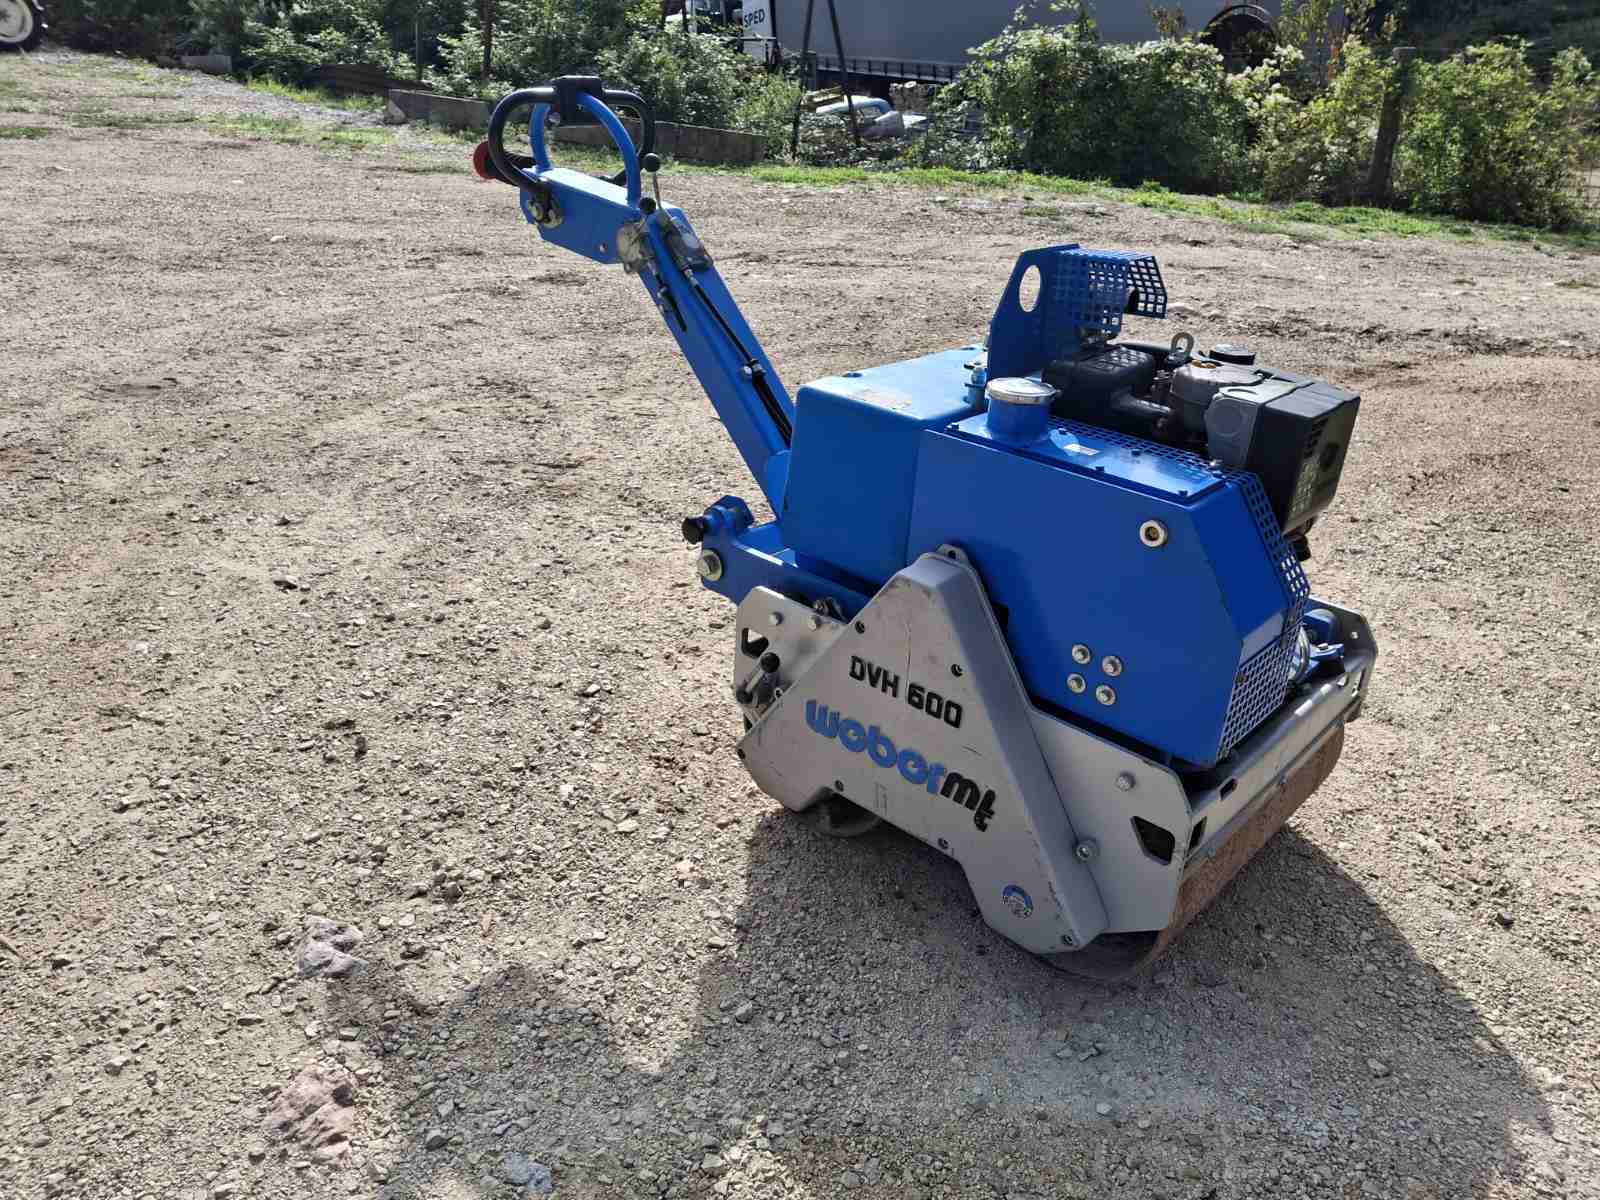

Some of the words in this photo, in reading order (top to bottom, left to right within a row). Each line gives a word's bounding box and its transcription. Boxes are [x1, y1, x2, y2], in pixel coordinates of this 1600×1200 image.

[744, 9, 765, 28] SPED
[849, 655, 899, 698] DVH
[907, 682, 963, 729] 600
